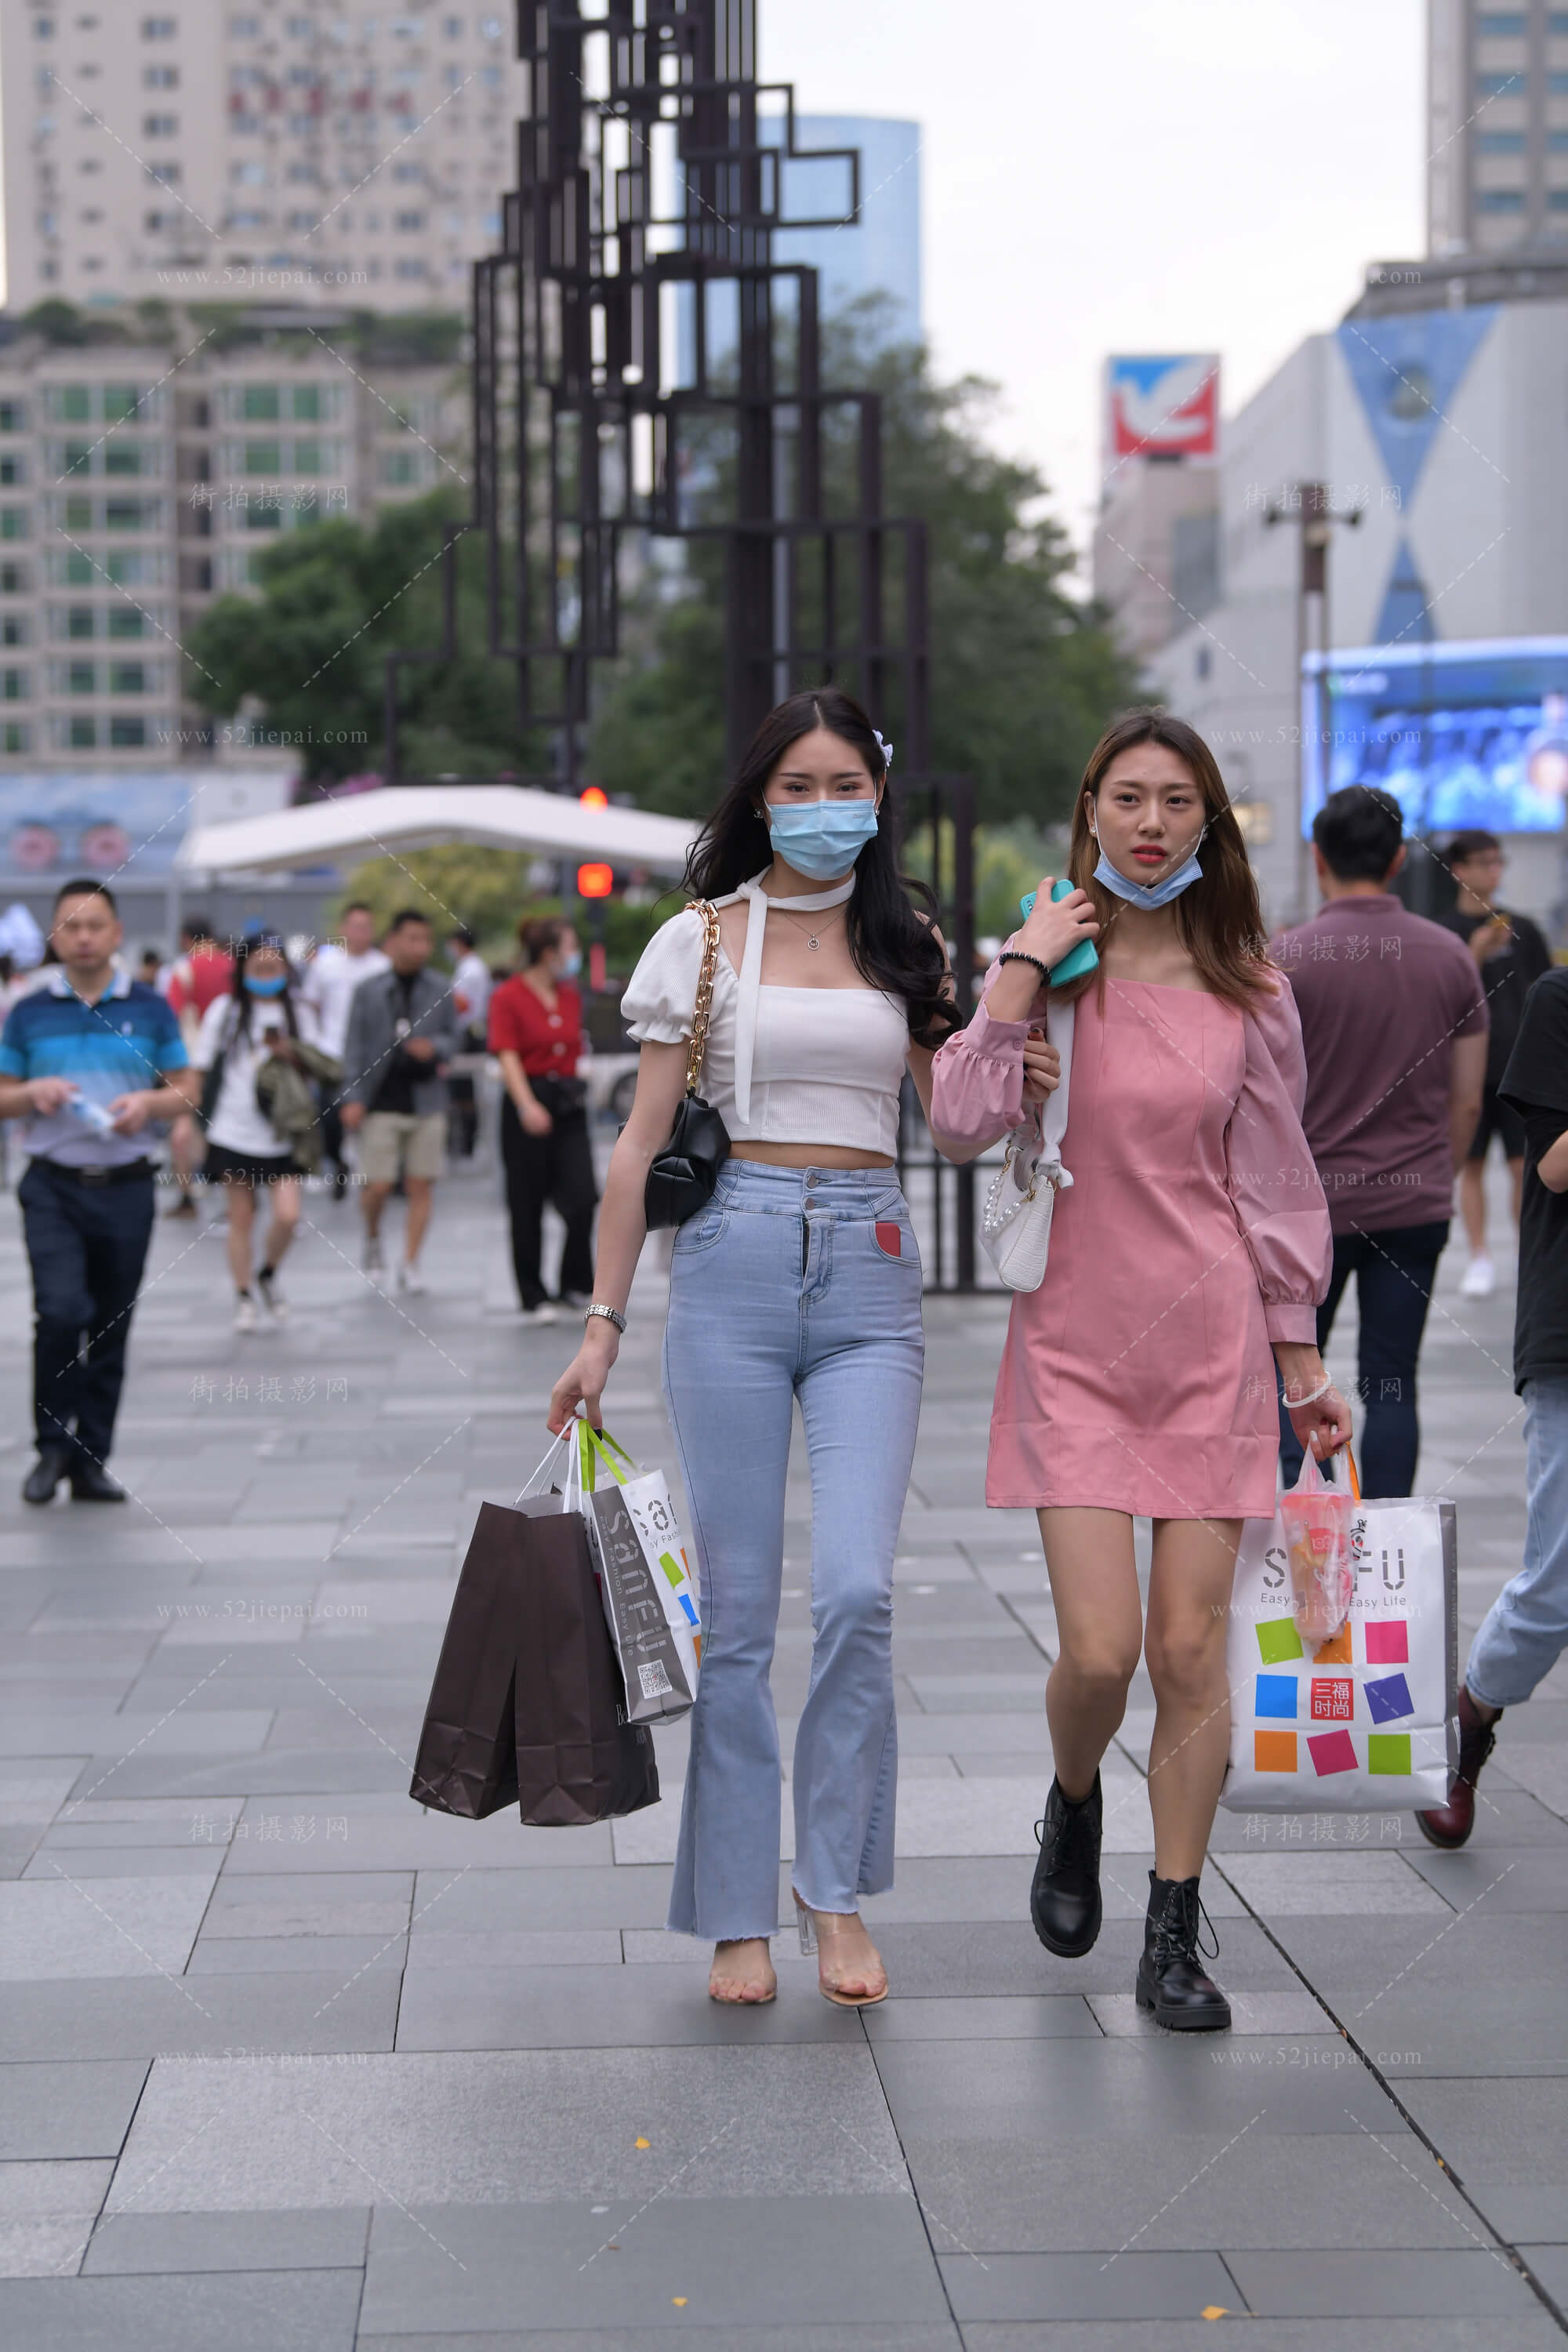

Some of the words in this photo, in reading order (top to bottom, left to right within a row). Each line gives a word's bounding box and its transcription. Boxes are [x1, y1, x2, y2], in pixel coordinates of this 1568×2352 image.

[1260, 1592, 1291, 1606] Easy
[1383, 1595, 1407, 1607] Life
[619, 1602, 629, 1631] Easy
[1314, 1681, 1349, 1700] 三福
[1314, 1699, 1349, 1718] 时尚
